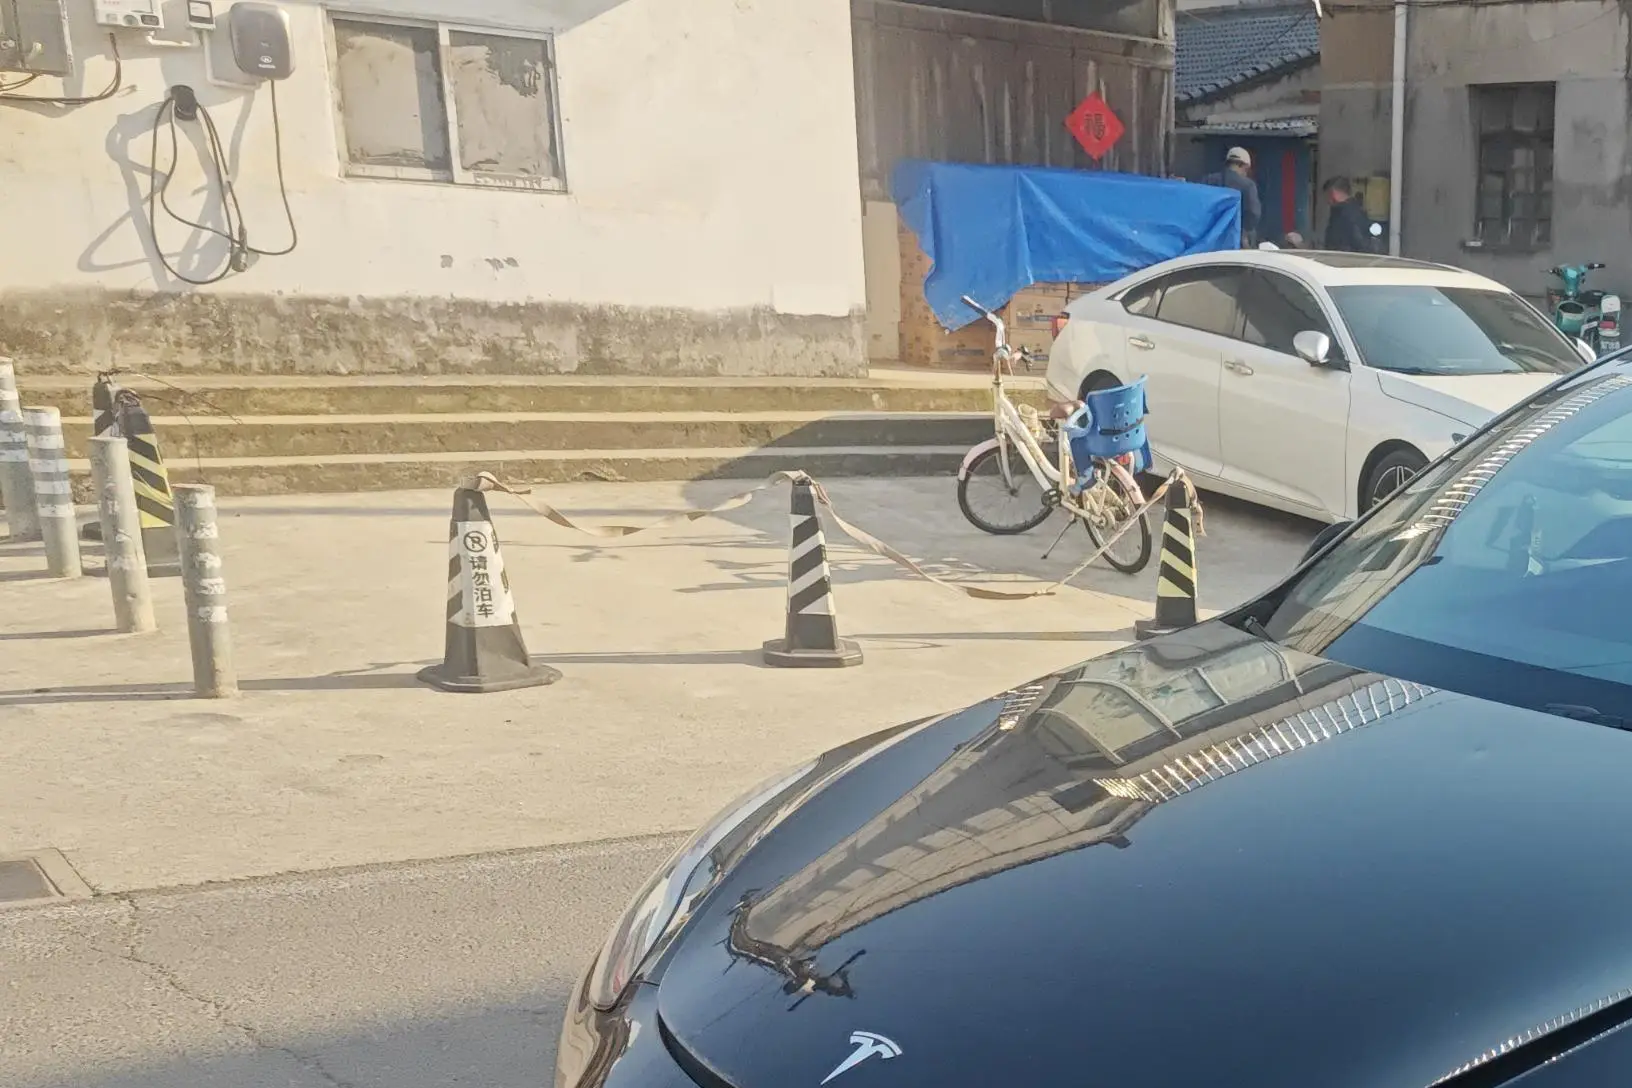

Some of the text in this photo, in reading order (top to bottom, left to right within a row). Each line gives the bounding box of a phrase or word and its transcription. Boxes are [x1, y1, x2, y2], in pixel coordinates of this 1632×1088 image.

[1083, 112, 1106, 141] 福
[469, 555, 495, 619] 请勿泊车
